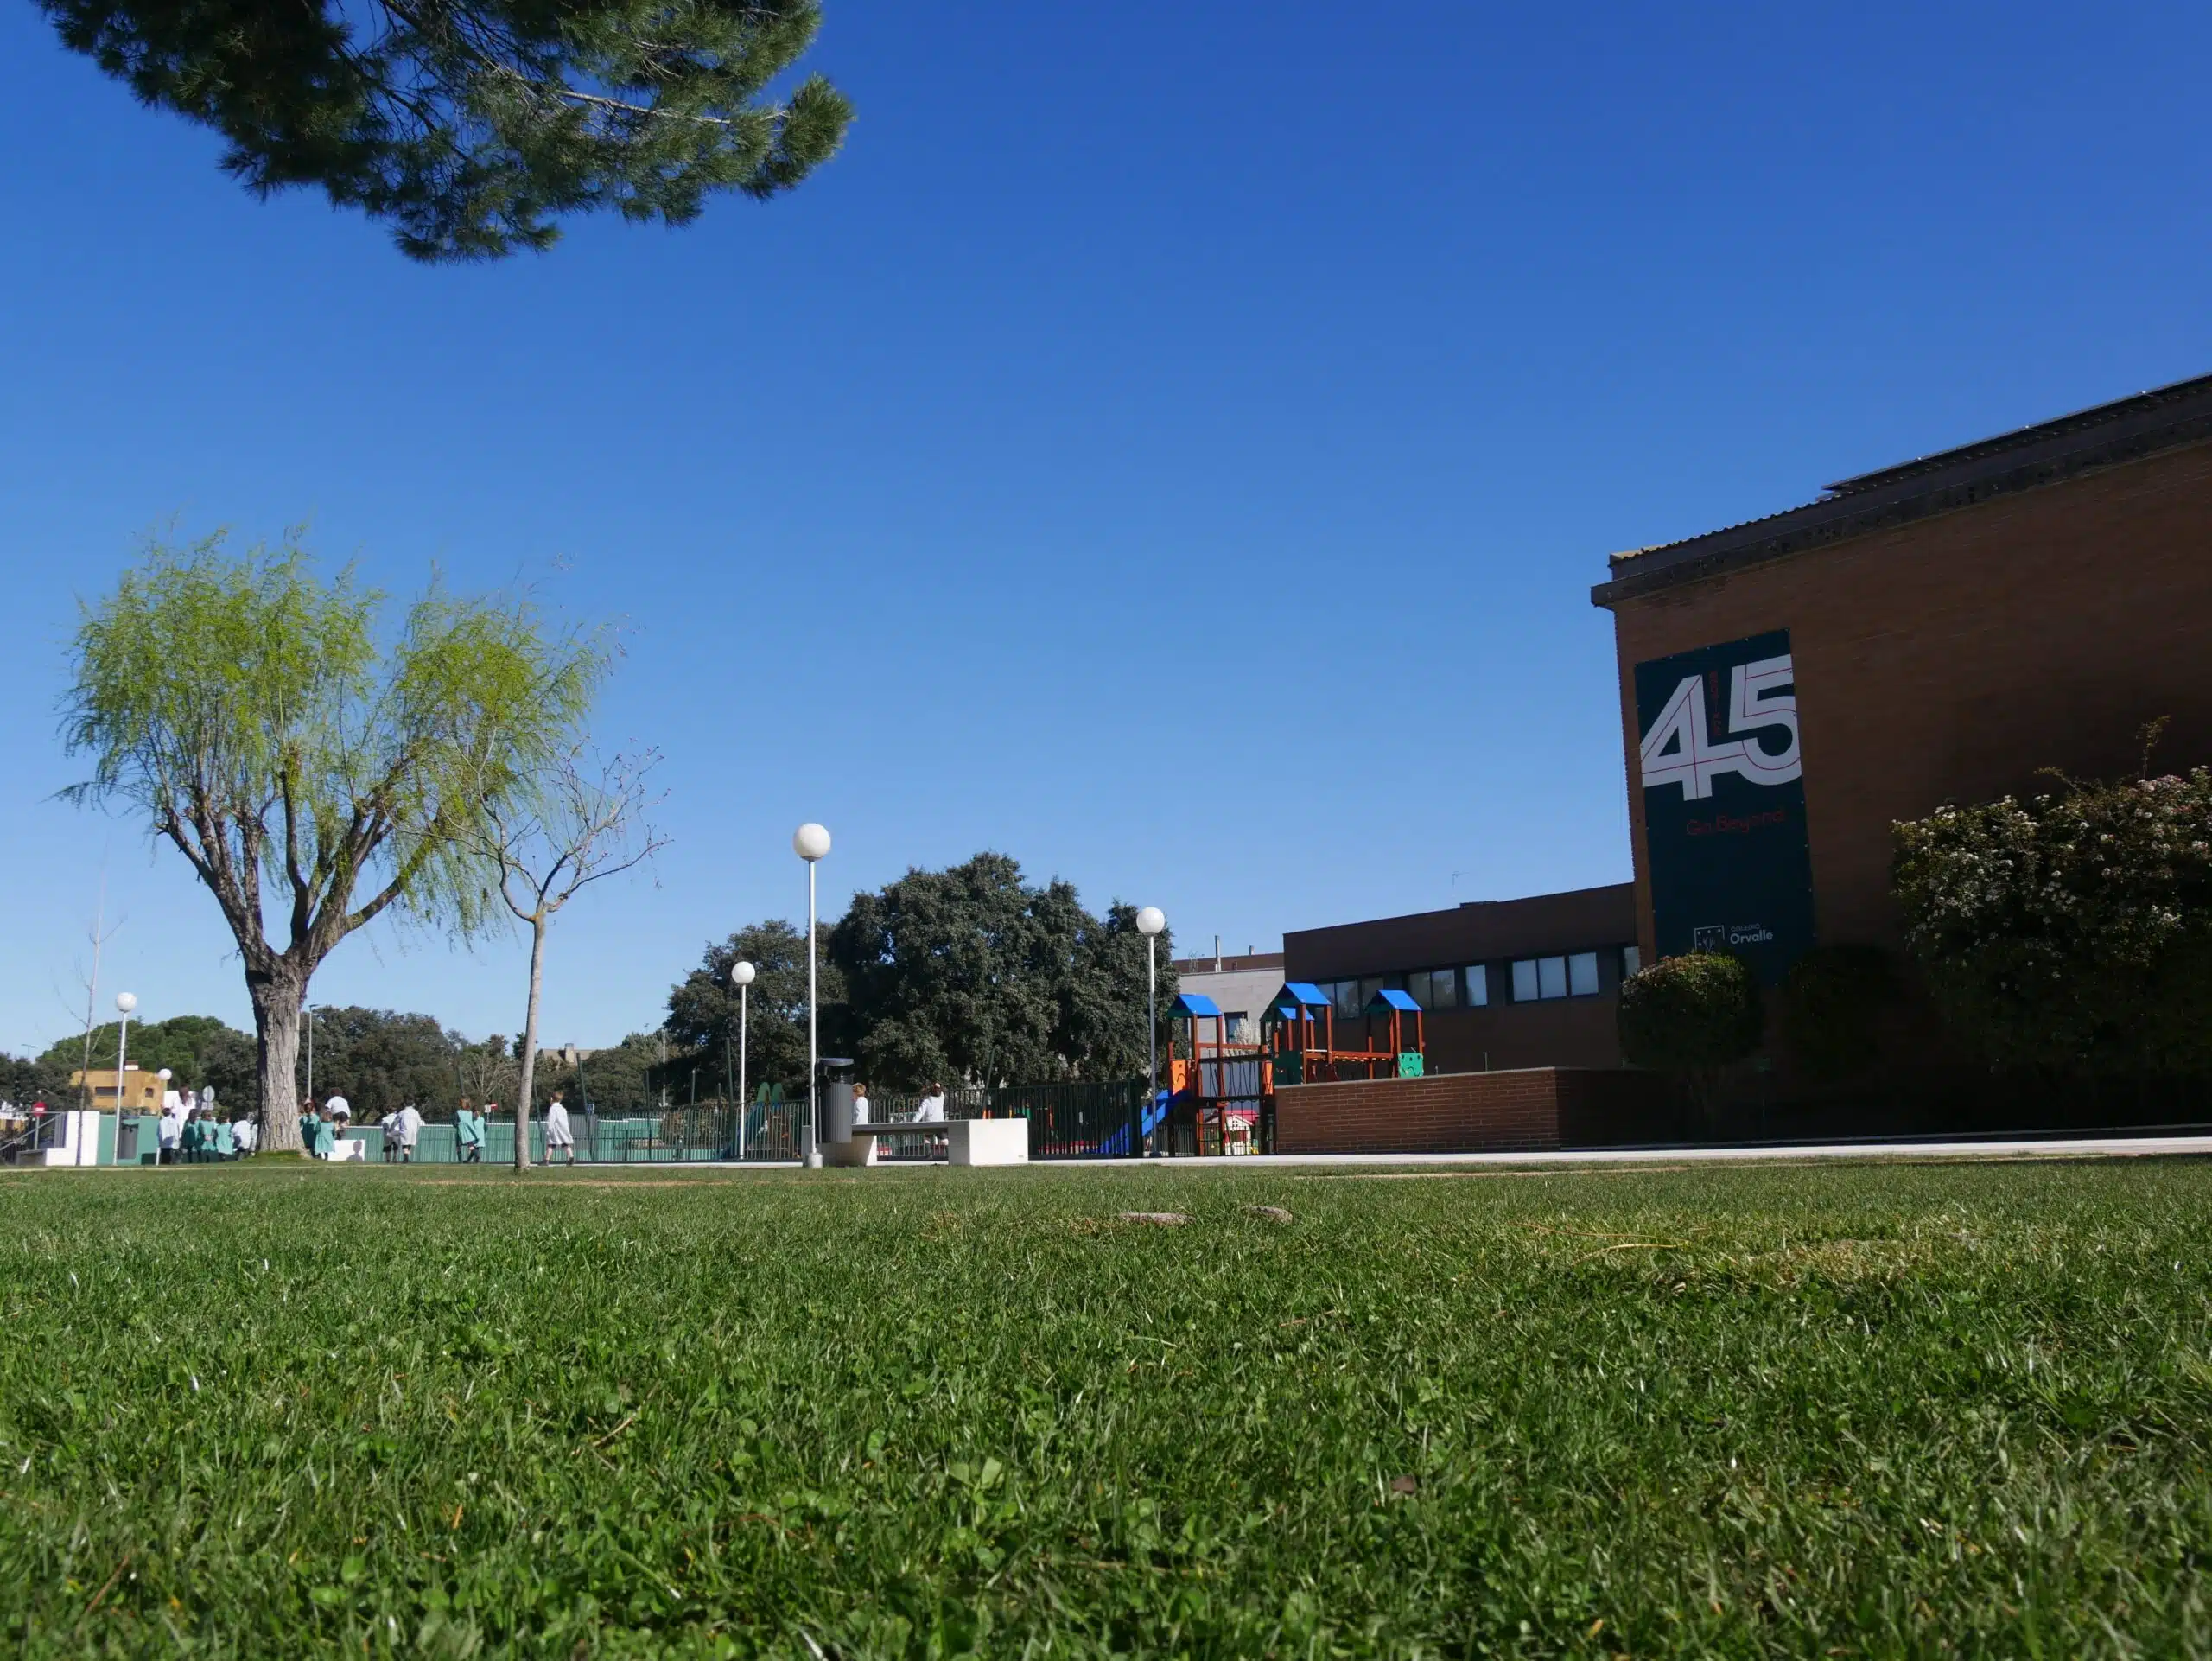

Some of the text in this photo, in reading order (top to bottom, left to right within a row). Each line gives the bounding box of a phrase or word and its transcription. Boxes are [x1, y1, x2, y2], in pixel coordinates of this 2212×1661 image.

[1640, 653, 1802, 801] 45
[1715, 807, 1784, 833] Beyond
[1730, 929, 1774, 945] Orvalle
